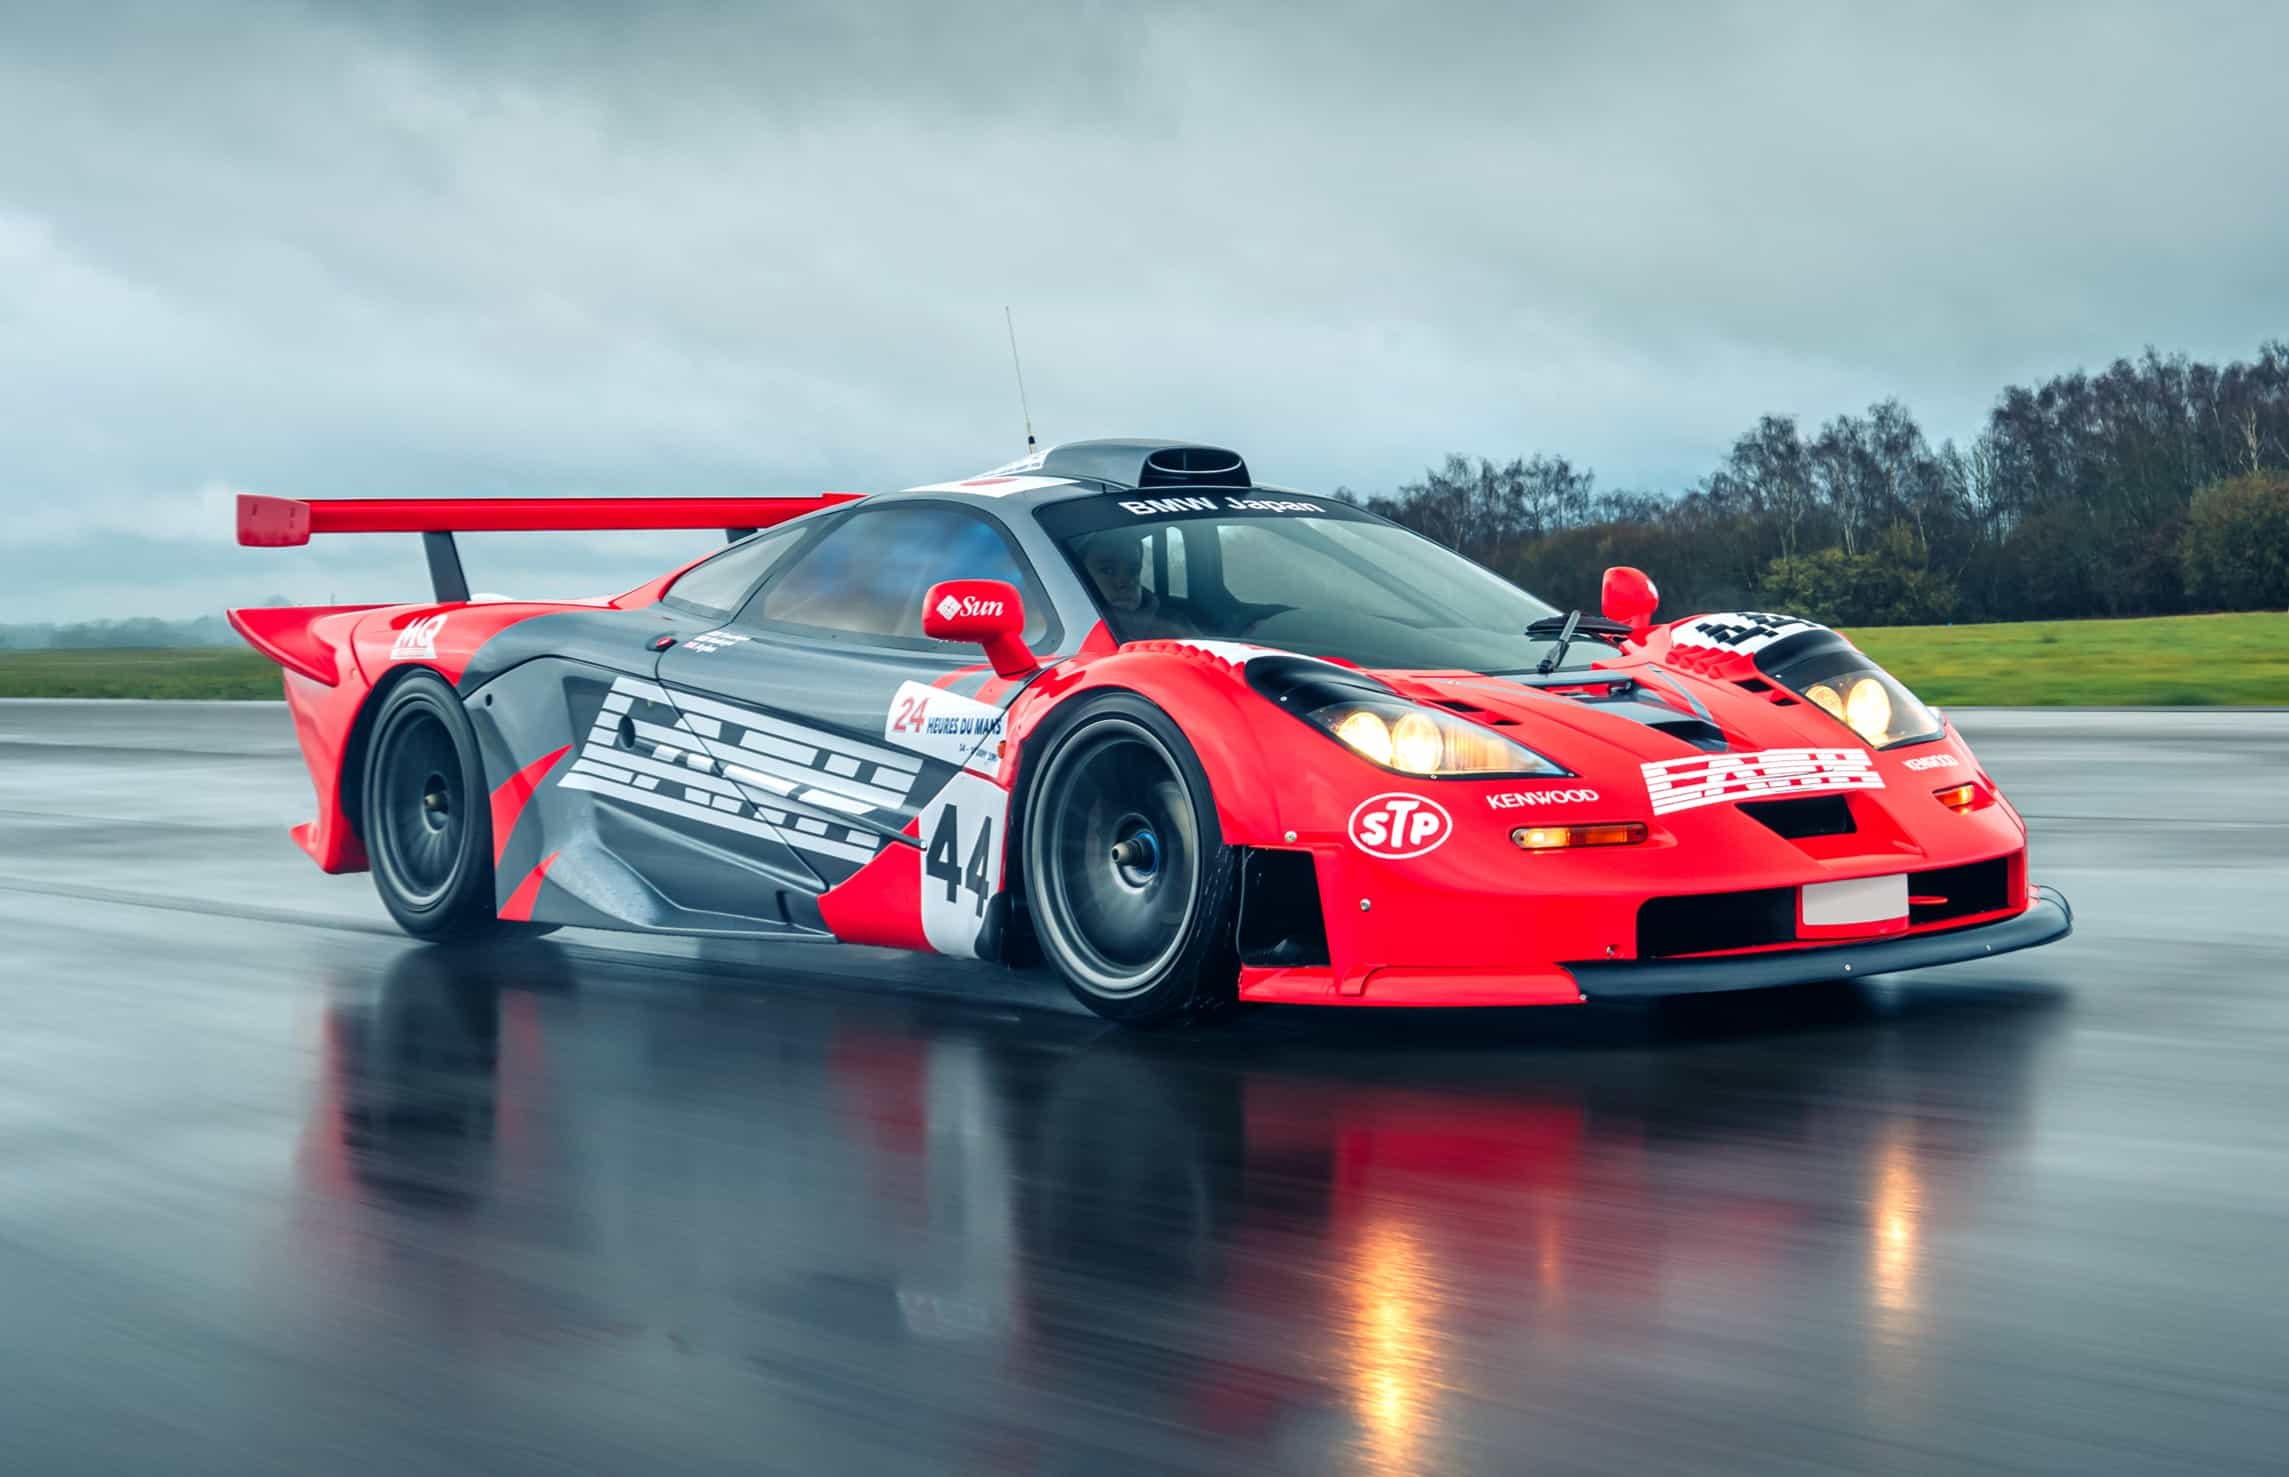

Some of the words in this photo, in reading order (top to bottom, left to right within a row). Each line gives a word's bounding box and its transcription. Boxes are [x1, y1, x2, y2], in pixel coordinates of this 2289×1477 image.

[1118, 497, 1219, 516] BMW
[1224, 496, 1326, 513] Japan
[960, 595, 1004, 617] Sun
[893, 696, 928, 733] 24
[927, 716, 960, 735] HEURES
[960, 716, 974, 735] DU
[975, 716, 1003, 735] MANS
[1486, 789, 1600, 810] KENWOOD
[1359, 800, 1440, 848] STP
[925, 803, 993, 919] 44
